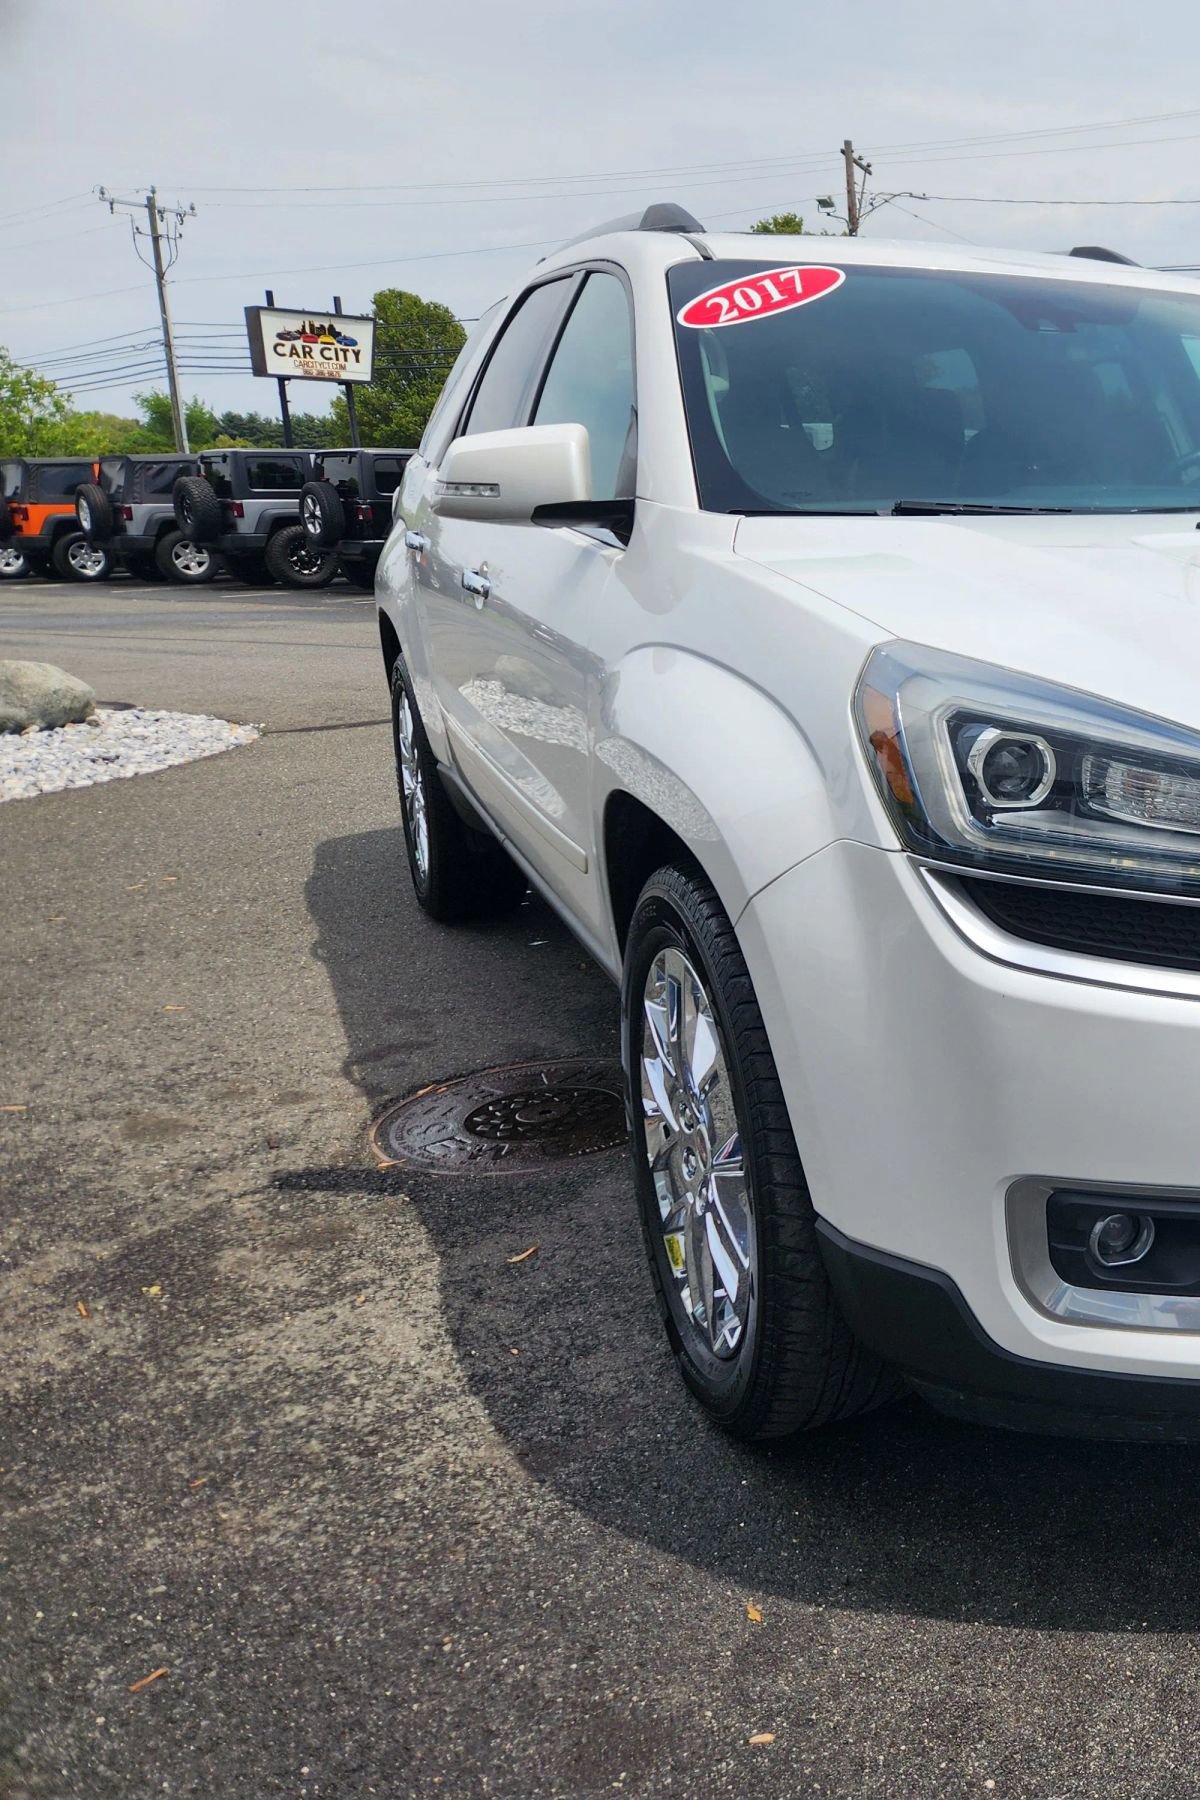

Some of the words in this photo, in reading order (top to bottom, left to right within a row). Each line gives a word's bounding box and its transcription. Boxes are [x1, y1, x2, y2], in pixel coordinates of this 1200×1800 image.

[706, 270, 803, 323] 2017
[273, 342, 314, 360] CAR
[320, 346, 361, 363] CITY
